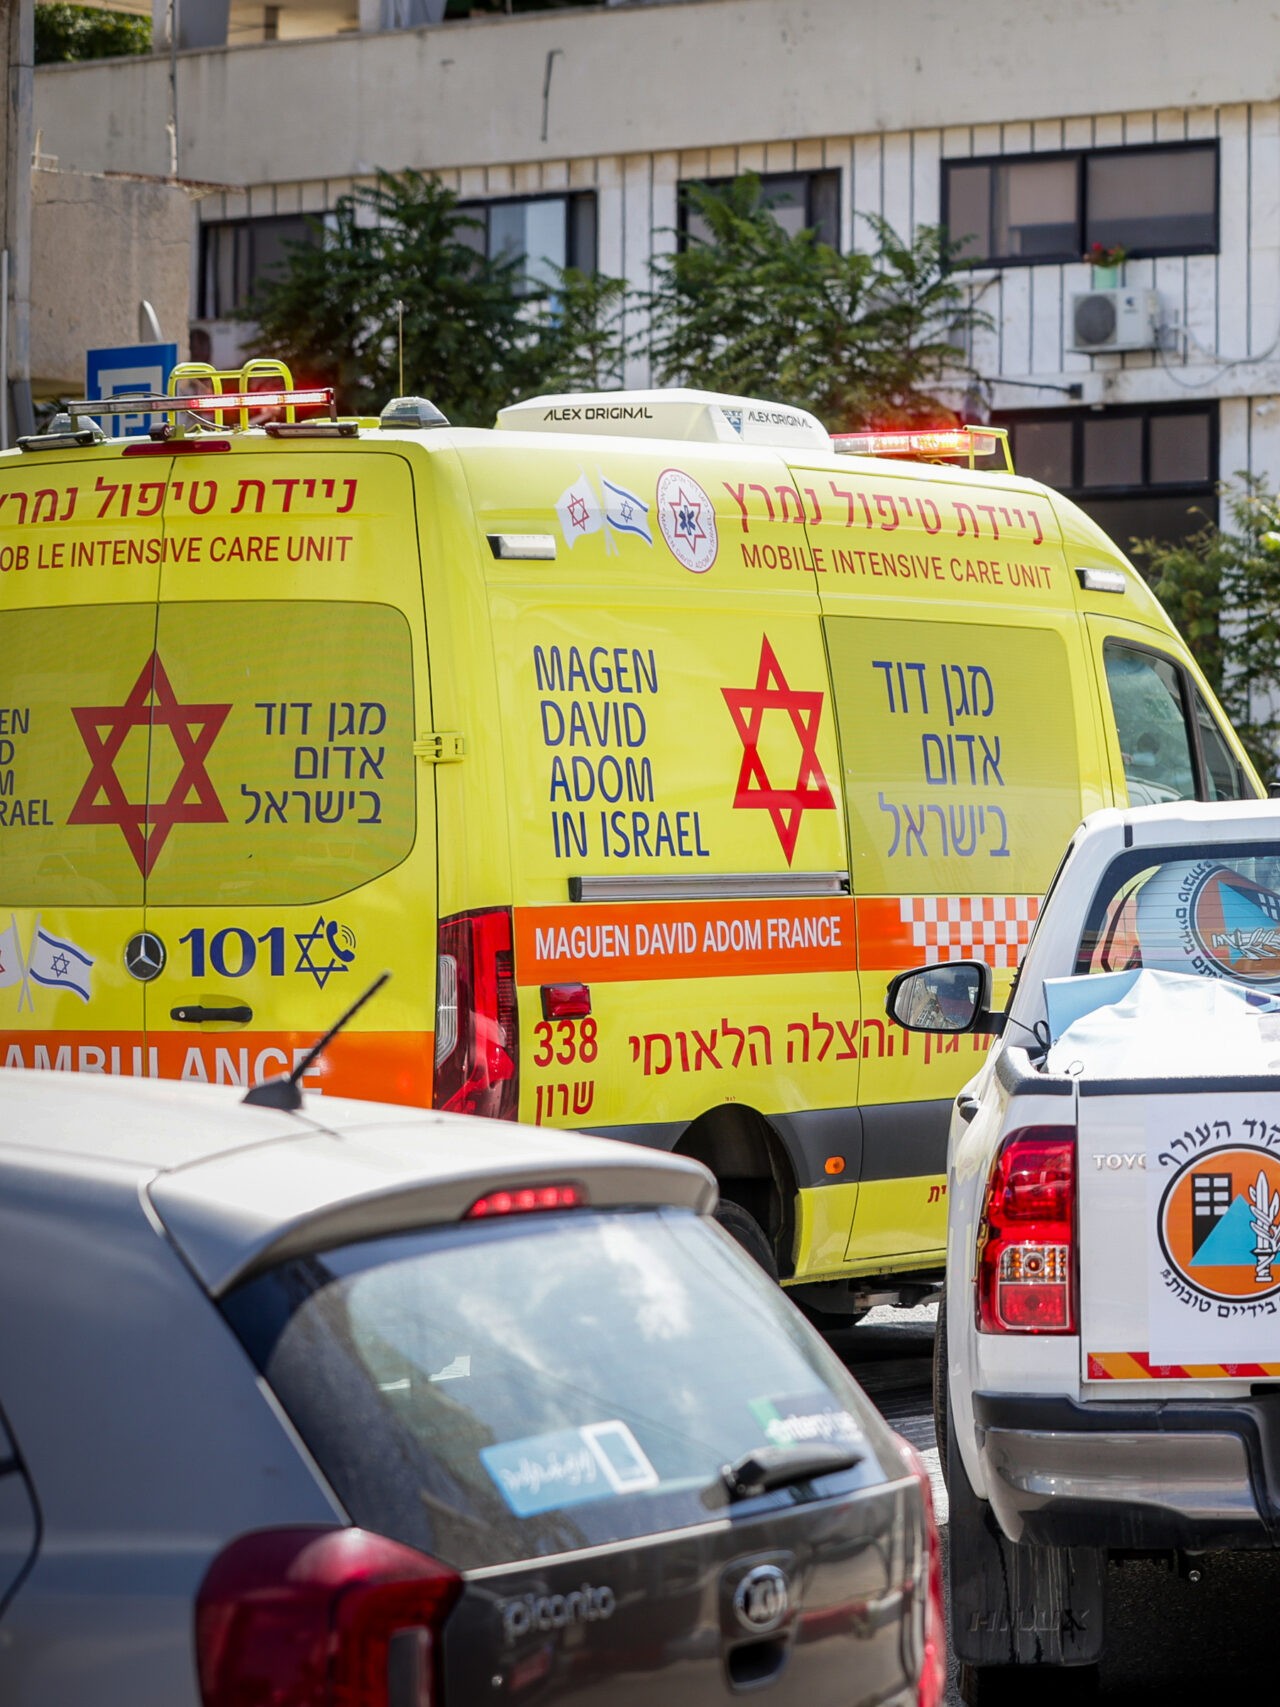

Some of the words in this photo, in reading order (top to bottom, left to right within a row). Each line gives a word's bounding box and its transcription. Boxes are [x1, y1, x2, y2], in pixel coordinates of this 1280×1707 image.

[543, 409, 582, 421] ALEX
[585, 407, 653, 420] ORIGINAL
[748, 411, 771, 423] ALEX
[94, 476, 218, 518] טיפול
[231, 478, 358, 514] ניידת
[722, 481, 822, 533] נמרץ
[829, 480, 942, 535] טיפול
[951, 501, 1044, 545] ניידת
[71, 537, 203, 567] INTENSIVE
[210, 536, 280, 563] CARE
[287, 535, 353, 562] UNIT
[740, 543, 827, 573] MOBILE
[831, 549, 945, 580] INTENSIVE
[949, 557, 1003, 585] CARE
[1007, 564, 1052, 589] UNIT
[532, 645, 658, 694] MAGEN
[872, 660, 926, 714] דוד
[941, 663, 995, 726] מגן
[255, 702, 313, 735] דוד
[328, 702, 387, 742] מגן
[540, 700, 647, 748] DAVID
[294, 746, 385, 780] אדום
[549, 755, 655, 802] ADOM
[922, 733, 1006, 786] אדום
[241, 784, 382, 824] בישראל
[878, 791, 1010, 858] בישראל
[552, 811, 588, 858] IN
[601, 811, 710, 858] ISRAEL
[178, 926, 285, 977] 101
[535, 925, 630, 960] MAGUEN
[635, 921, 698, 956] DAVID
[702, 919, 762, 952] ADOM
[767, 916, 842, 949] FRANCE
[533, 1017, 598, 1067] 338
[628, 1018, 772, 1076] הלאומי
[535, 1080, 595, 1128] שרון
[1158, 1119, 1232, 1167] העורף
[1217, 1300, 1277, 1319] בידיים
[503, 1582, 615, 1646] picanto
